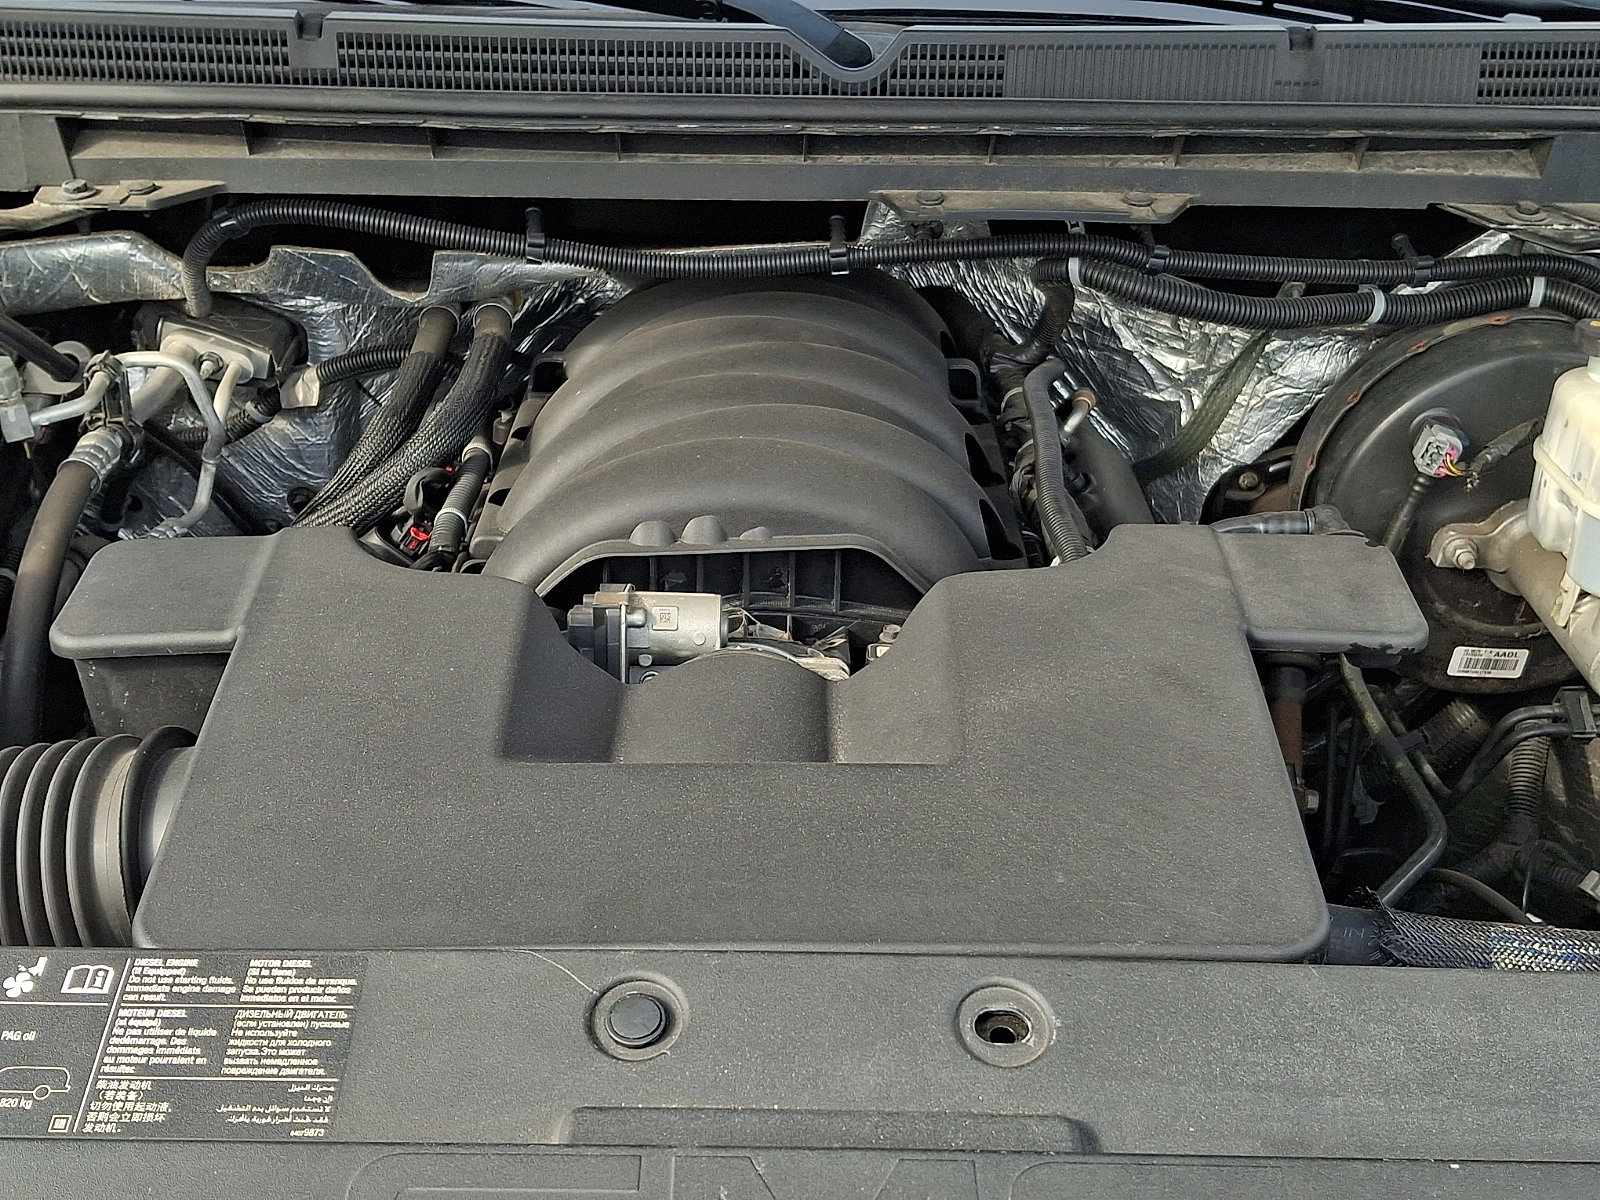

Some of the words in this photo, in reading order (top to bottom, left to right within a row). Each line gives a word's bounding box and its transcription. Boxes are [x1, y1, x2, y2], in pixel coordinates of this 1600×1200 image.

[133, 959, 165, 967] DIESEL
[165, 959, 200, 967] ENGINE
[249, 959, 282, 968] MOTOR
[281, 959, 313, 968] DIESEL
[128, 975, 141, 983] Do
[174, 976, 208, 986] starting
[244, 976, 258, 985] No
[275, 977, 305, 985] fluidos
[304, 977, 317, 985] de
[125, 984, 171, 992] Immediate
[171, 985, 201, 994] engine
[201, 985, 237, 995] damage
[242, 985, 255, 993] Se
[254, 986, 287, 995] pueden
[287, 986, 324, 995] producir
[239, 993, 287, 1002] inmediatos
[300, 994, 310, 1003] el
[118, 1008, 156, 1017] MOTEUR
[156, 1009, 188, 1018] DIESEL
[235, 1009, 294, 1019] ДИЗЕЛЬНЫЙ
[293, 1010, 348, 1020] ДВИГАТЕЛЬ
[1, 1031, 22, 1041] PAG
[22, 1031, 36, 1041] oil
[112, 1027, 125, 1035] Ne
[125, 1028, 143, 1037] pas
[143, 1027, 174, 1036] utiliser
[174, 1028, 187, 1036] de
[187, 1027, 217, 1037] liquide
[231, 1028, 244, 1036] Не
[170, 1037, 188, 1045] Des
[227, 1039, 269, 1047] жидкости
[286, 1040, 332, 1048] холодного
[106, 1045, 155, 1055] dommages
[155, 1046, 202, 1054] immédiats
[260, 1047, 278, 1055] Это
[116, 1055, 149, 1063] moteur
[149, 1056, 195, 1065] pourraient
[223, 1057, 259, 1065] вызвать
[260, 1058, 319, 1066] немедленное
[220, 1067, 279, 1076] повреждение
[95, 1080, 152, 1090] 柴油发动机
[19, 1096, 33, 1110] kg
[86, 1111, 167, 1123] 否则会立即损坏
